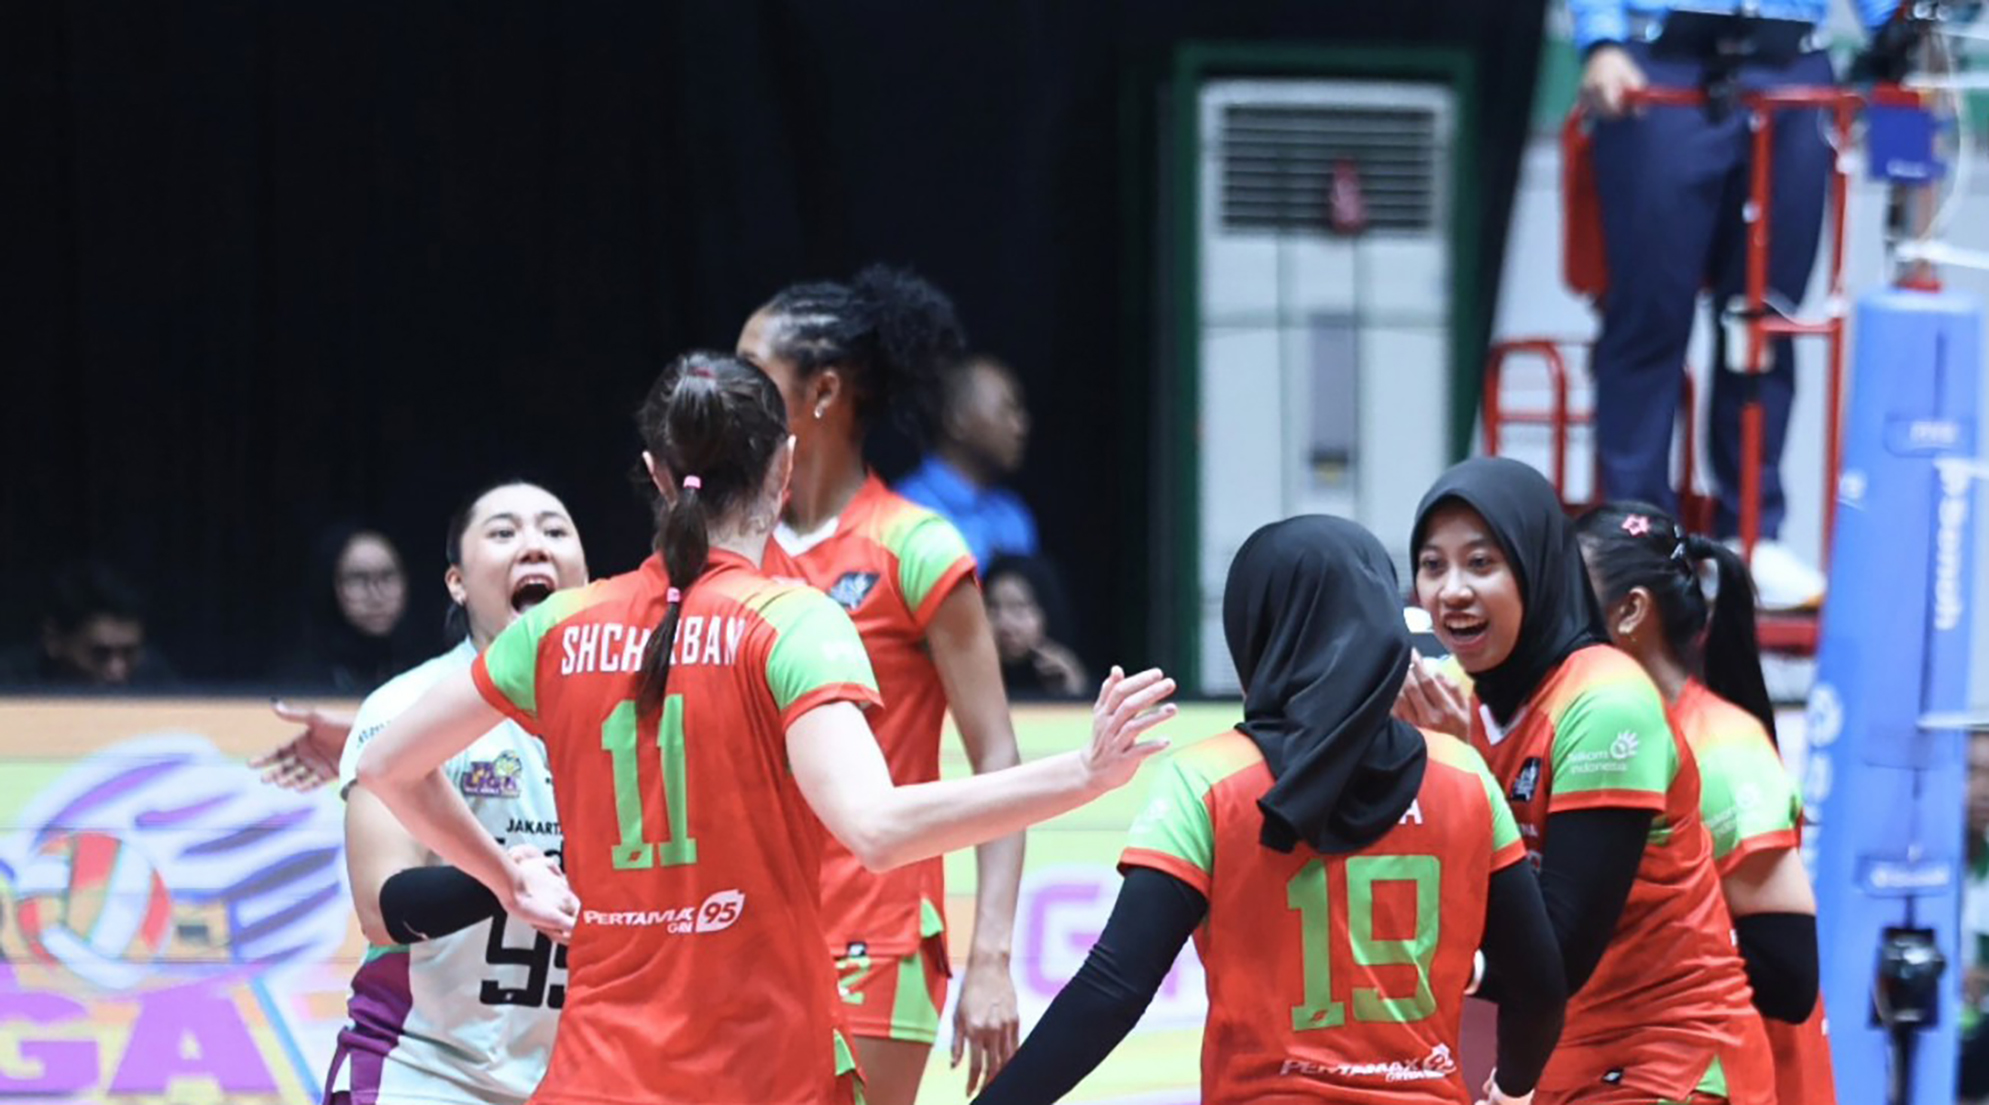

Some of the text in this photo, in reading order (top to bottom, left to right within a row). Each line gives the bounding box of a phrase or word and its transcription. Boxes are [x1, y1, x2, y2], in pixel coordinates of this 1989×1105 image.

[561, 615, 746, 675] SHCHBAN
[601, 694, 697, 869] 11
[506, 818, 563, 836] JAKART
[704, 902, 737, 924] 95
[1287, 854, 1441, 1031] 19
